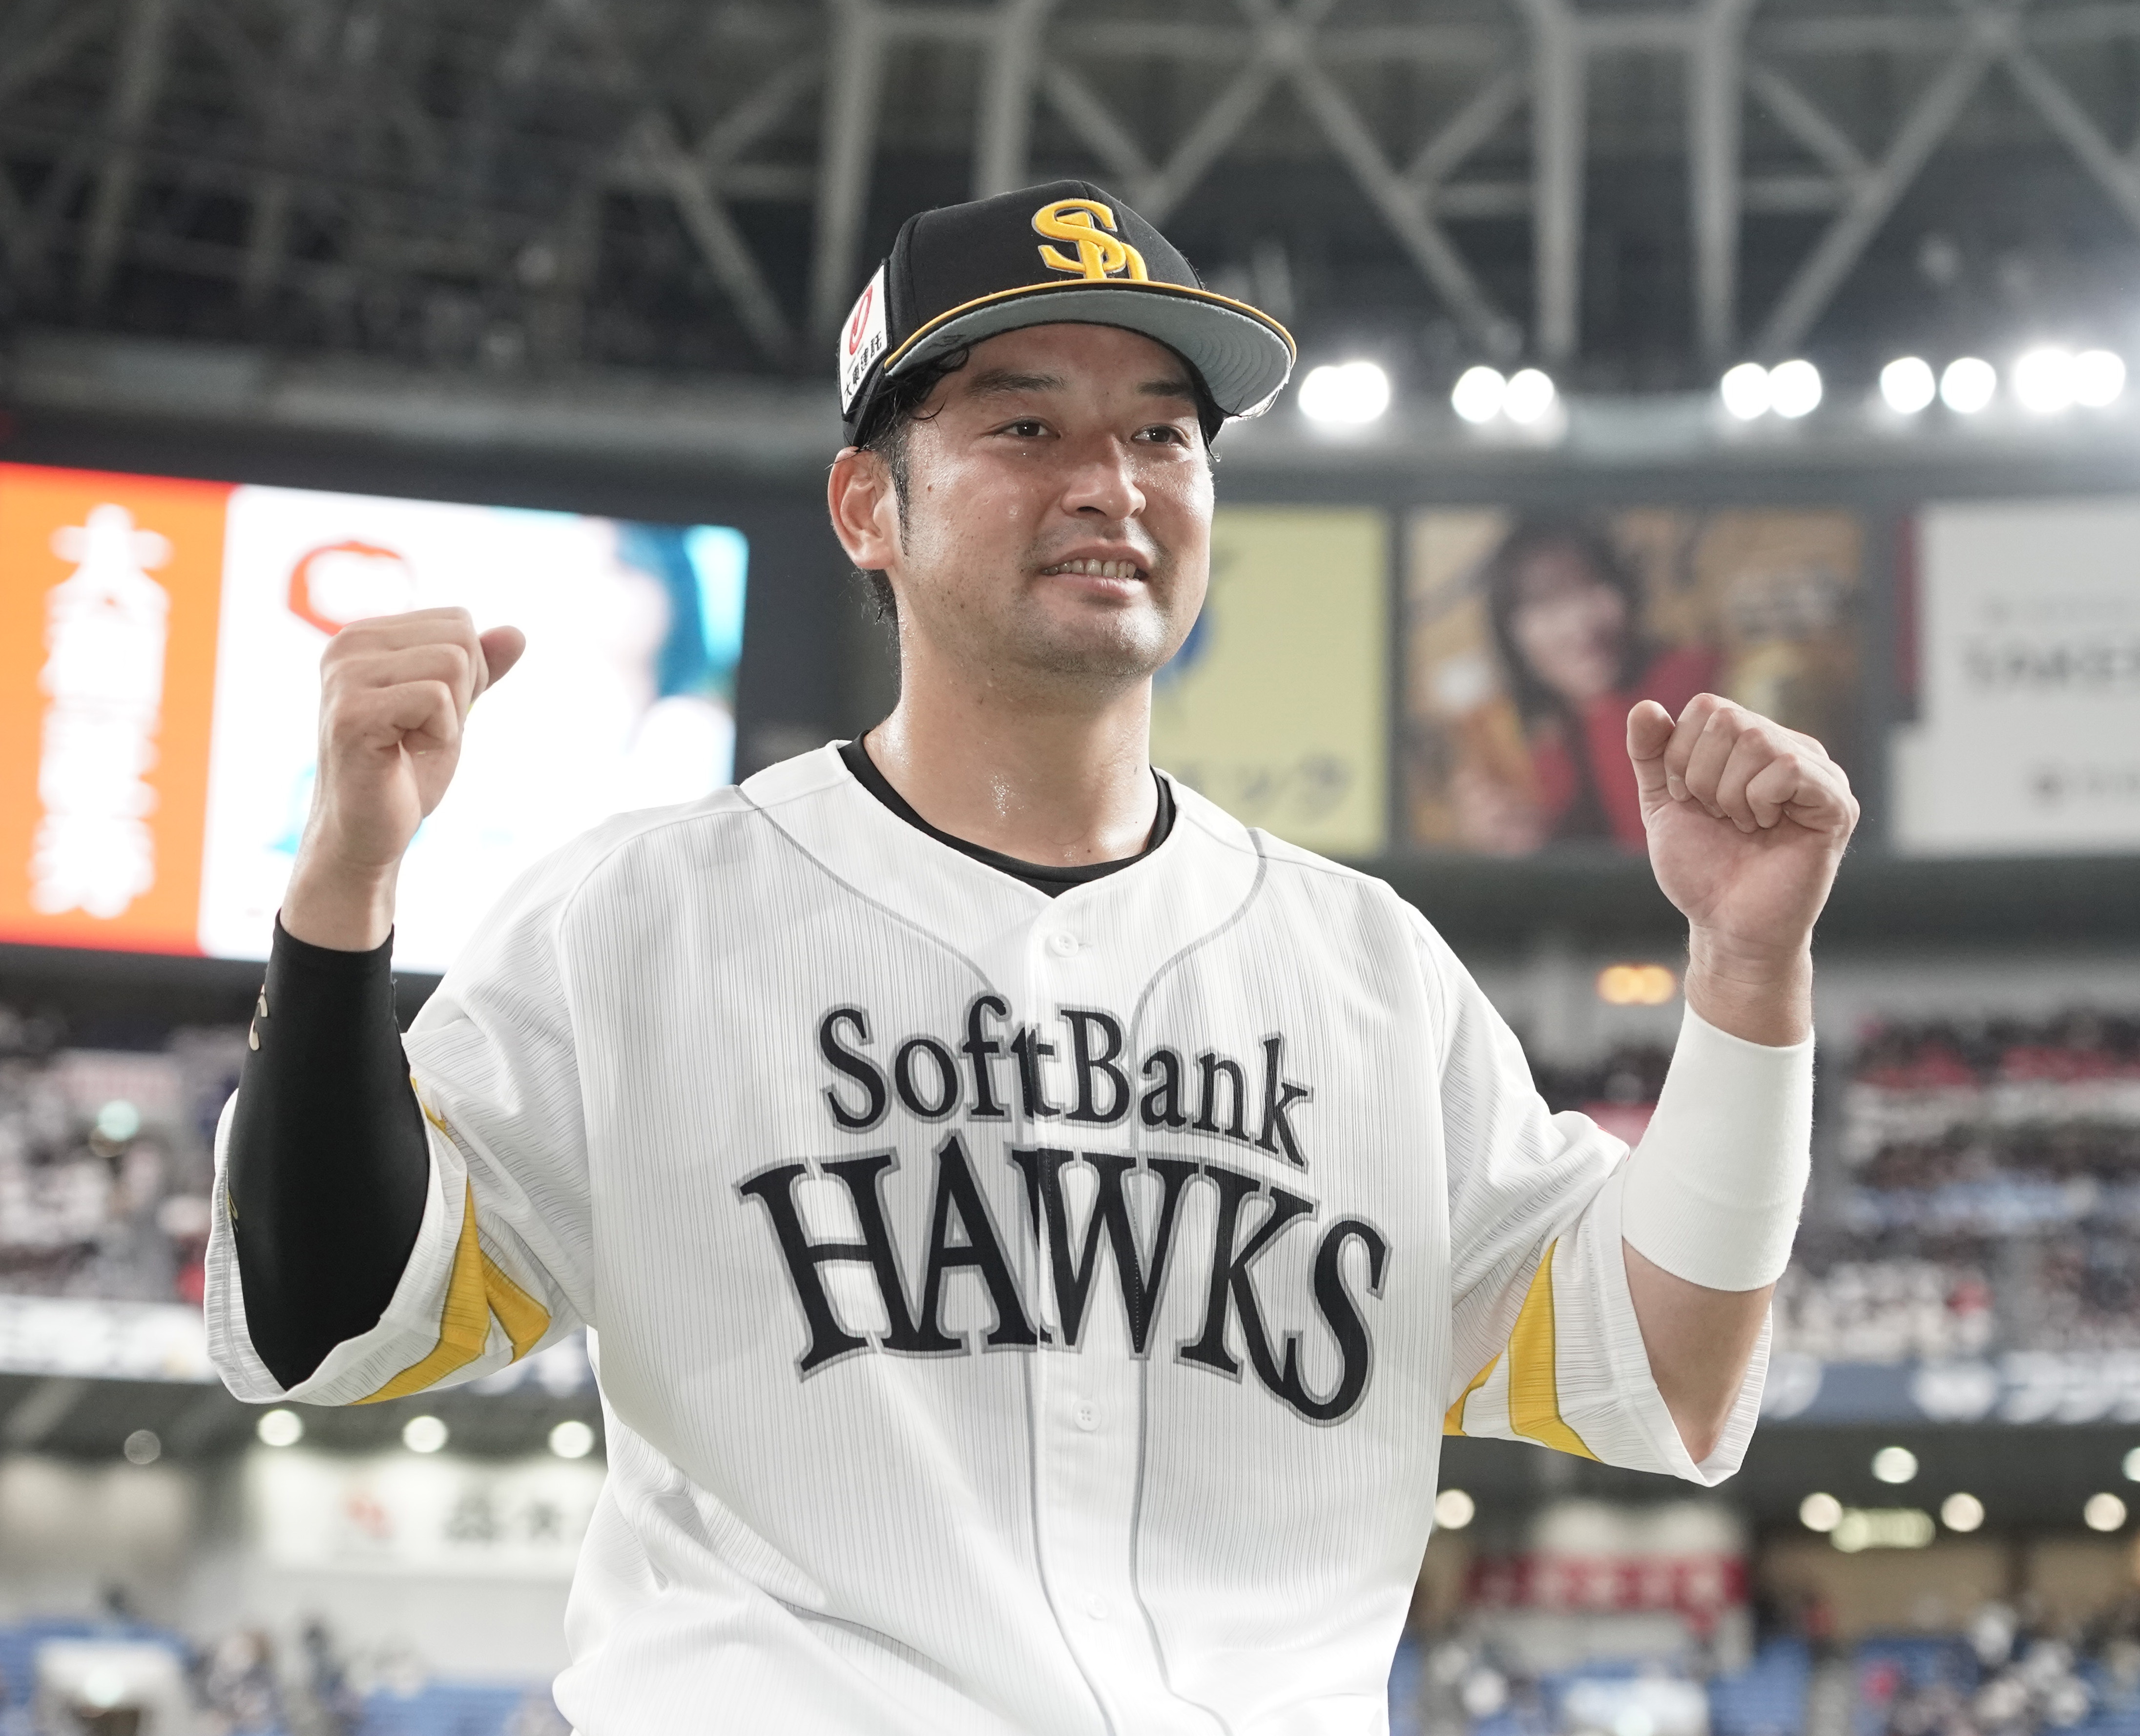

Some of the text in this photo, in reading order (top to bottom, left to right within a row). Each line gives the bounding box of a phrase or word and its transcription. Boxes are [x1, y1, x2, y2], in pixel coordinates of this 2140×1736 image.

[844, 331, 882, 407] 大東建託
[814, 992, 1312, 1172] SoftBank
[733, 1130, 1392, 1426] HAWKS
